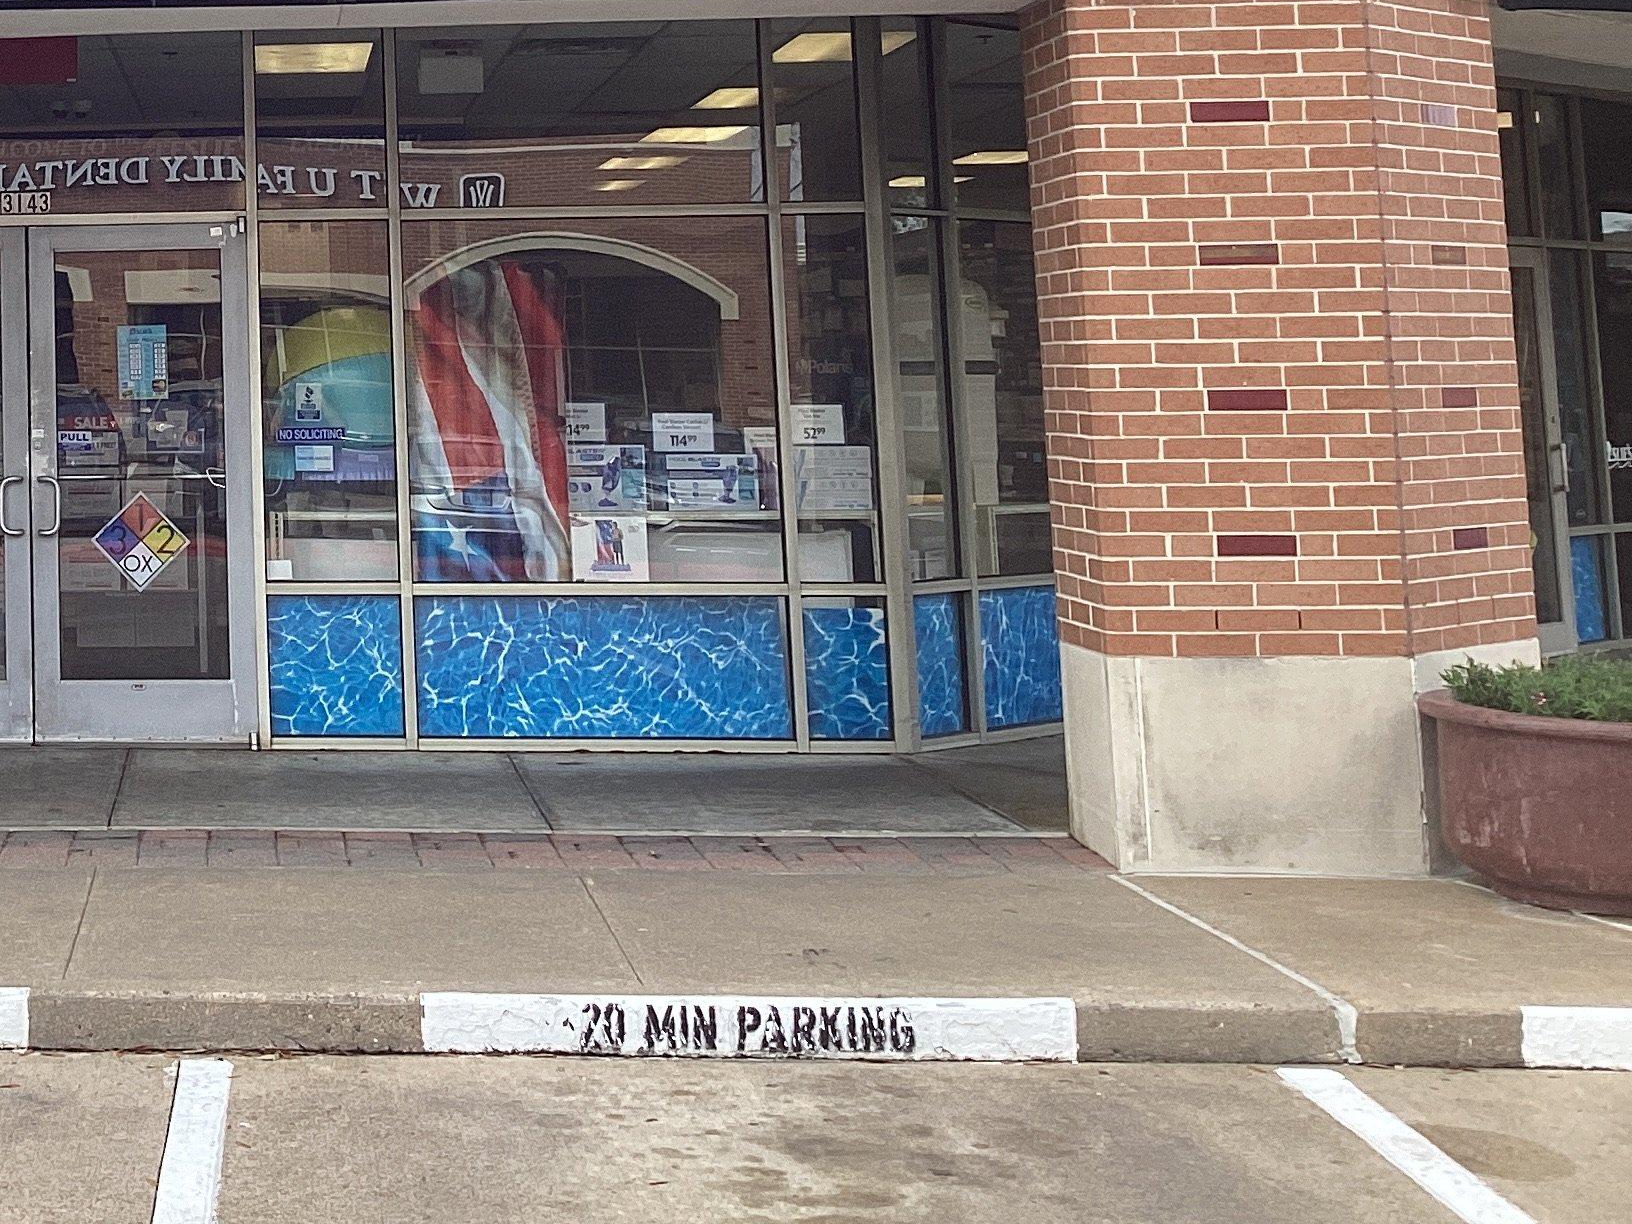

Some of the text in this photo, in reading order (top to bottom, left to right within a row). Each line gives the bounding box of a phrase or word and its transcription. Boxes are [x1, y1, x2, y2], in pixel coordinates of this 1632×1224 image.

[1, 193, 50, 213] 3143
[74, 416, 108, 429] SALE
[60, 432, 89, 442] PULL
[279, 428, 343, 440] NO SOLICITING
[135, 502, 144, 532] 1
[109, 525, 127, 555] 3
[156, 524, 175, 555] 2
[123, 554, 154, 573] OX
[580, 1002, 917, 1053] 20 MIN PARKING
